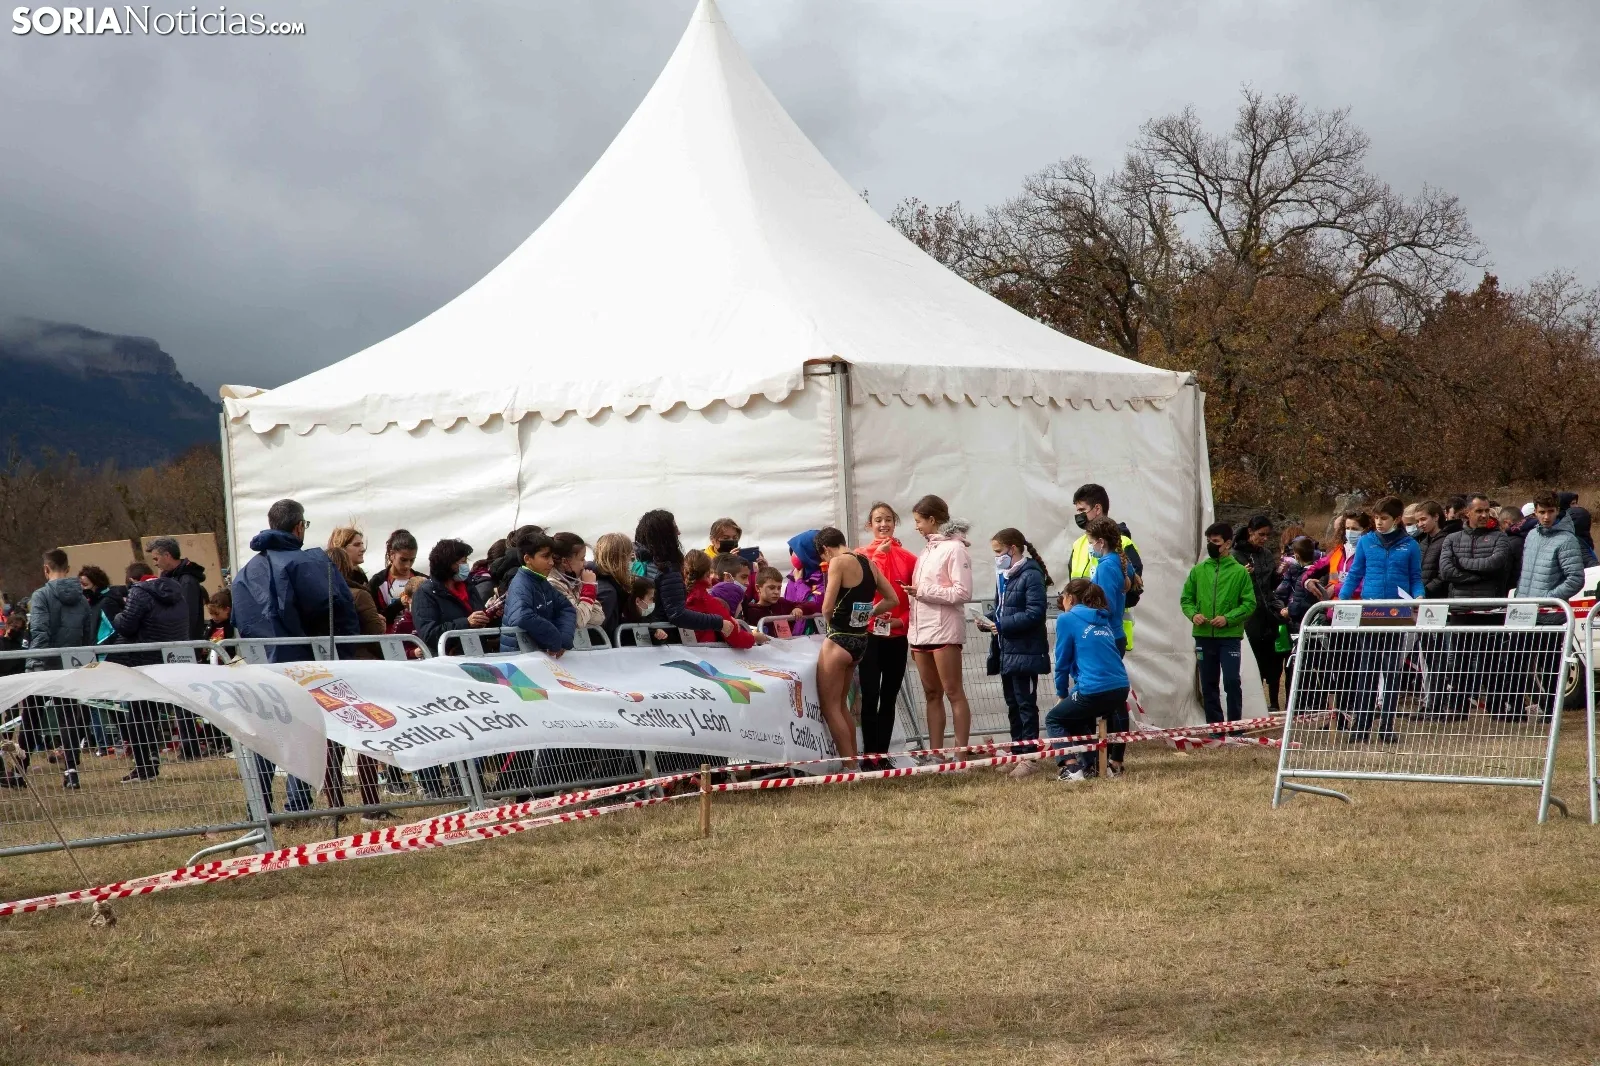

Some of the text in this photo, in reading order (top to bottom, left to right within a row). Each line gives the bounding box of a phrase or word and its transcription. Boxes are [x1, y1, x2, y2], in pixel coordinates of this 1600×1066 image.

[397, 689, 500, 719] Junta de
[689, 686, 716, 701] de
[361, 710, 529, 752] Castilla y León
[617, 708, 732, 736] Castilla y León
[790, 721, 818, 751] Castilla
[815, 735, 824, 760] y
